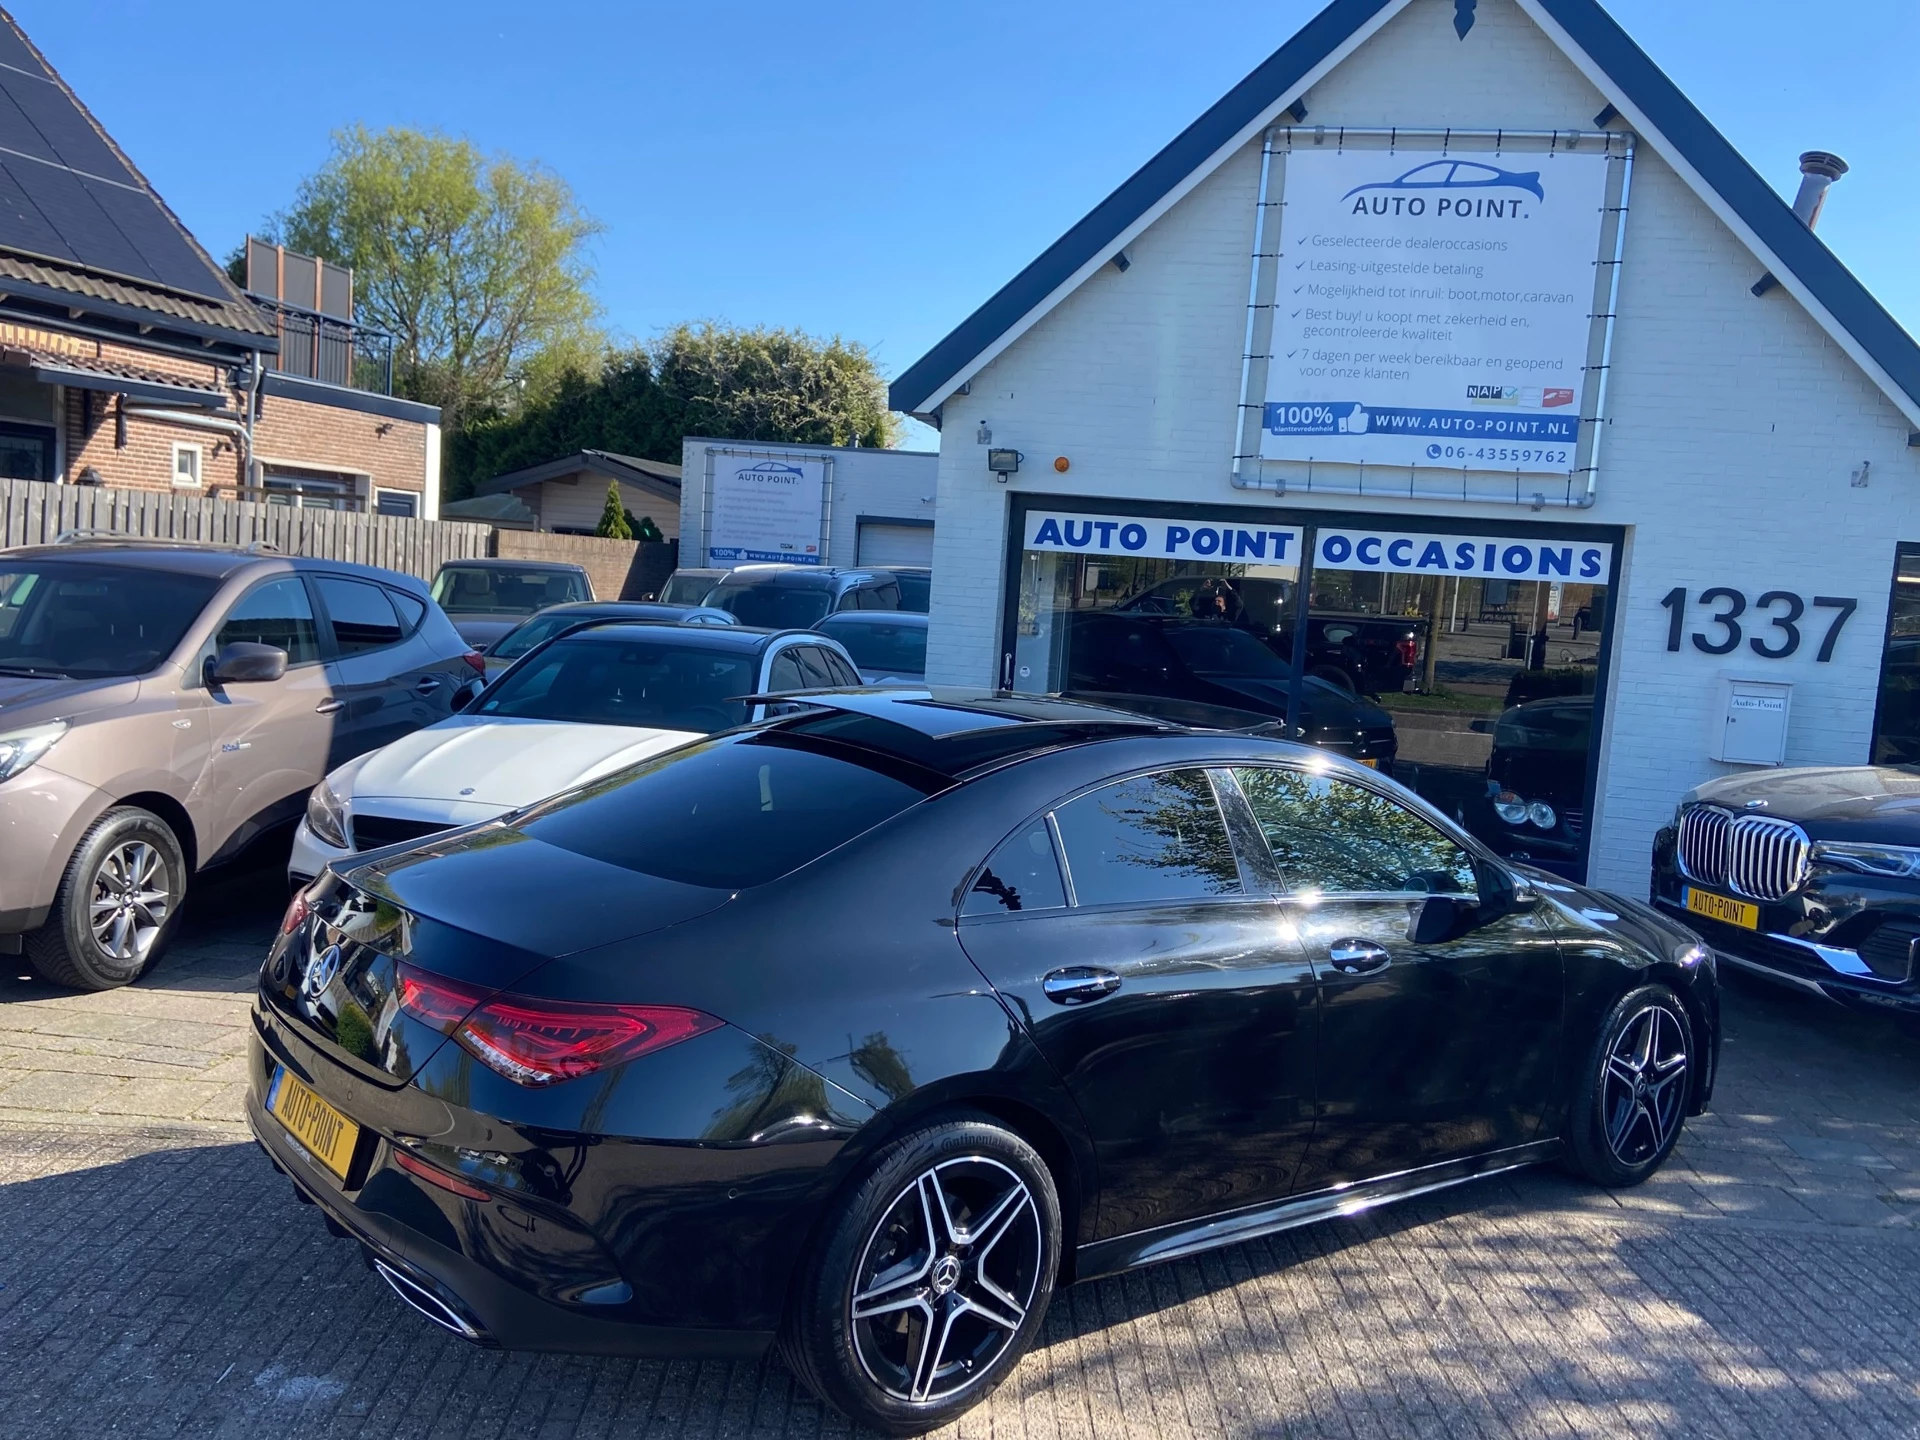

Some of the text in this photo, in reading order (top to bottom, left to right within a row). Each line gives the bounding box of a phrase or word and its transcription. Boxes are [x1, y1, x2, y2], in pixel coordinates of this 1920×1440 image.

[1352, 196, 1427, 217] AUTO
[1312, 234, 1508, 251] Geselecteerde dealeroccasions
[1309, 259, 1484, 278] Leasing-uitgestelde betaling
[1308, 284, 1385, 299] Mogelijkheid
[1389, 287, 1407, 298] tot
[1410, 287, 1444, 299] inruil:
[1305, 308, 1530, 328] Best buy! u koopt met zekerheid en,
[1303, 326, 1453, 341] gecontroleerde kwaliteit
[1302, 349, 1564, 372] 7 dagen per week bereikbaar en geopend
[1299, 367, 1410, 380] voor onze klanten
[1467, 385, 1502, 398] NAP
[1274, 425, 1334, 433] klanttevredenheid
[1276, 406, 1570, 435] 100% WWW.AUTO-POINT.NL
[1445, 446, 1567, 464] 06-43559762
[738, 473, 764, 482] AUTO
[1033, 518, 1601, 578] AUTO POINT OCCASIONS
[1660, 587, 1858, 663] 1337
[1733, 698, 1782, 709] Auto-Point
[1693, 892, 1746, 923] AUTO-POINT
[281, 1079, 344, 1162] AUTO-POINT
